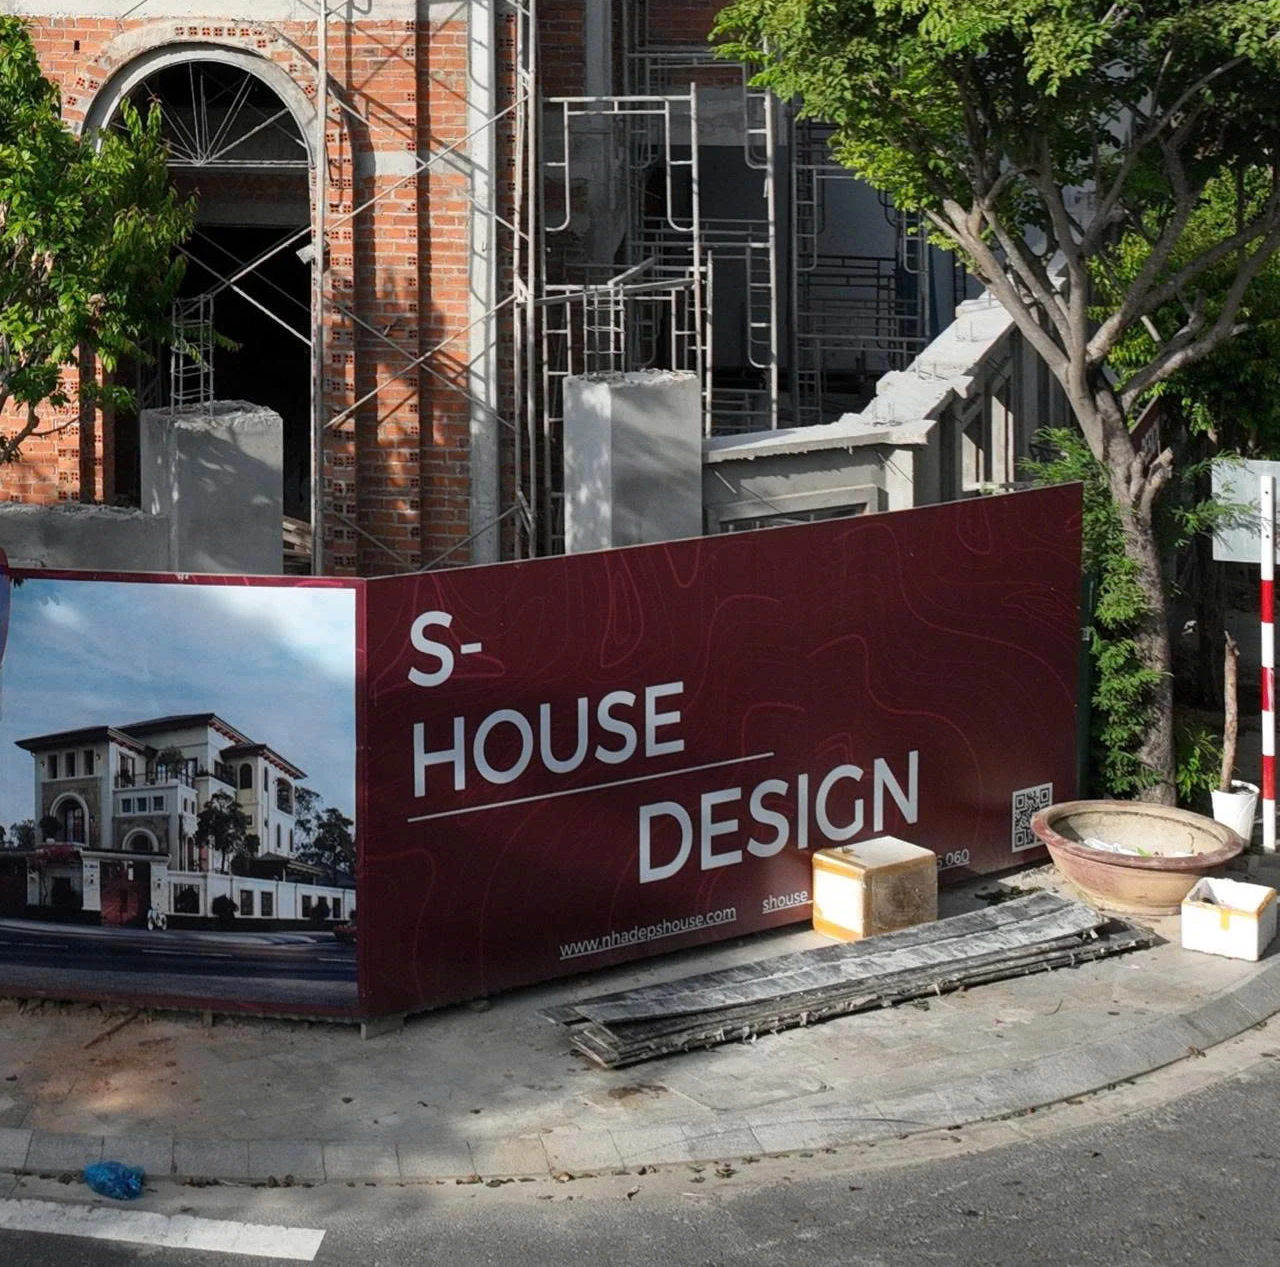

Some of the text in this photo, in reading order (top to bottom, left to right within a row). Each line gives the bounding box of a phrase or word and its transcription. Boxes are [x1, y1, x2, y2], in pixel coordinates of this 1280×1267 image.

[407, 610, 483, 688] S-
[413, 681, 685, 798] HOUSE
[638, 750, 920, 884] DESIGN
[560, 905, 737, 959] www.nhadepshouse.com
